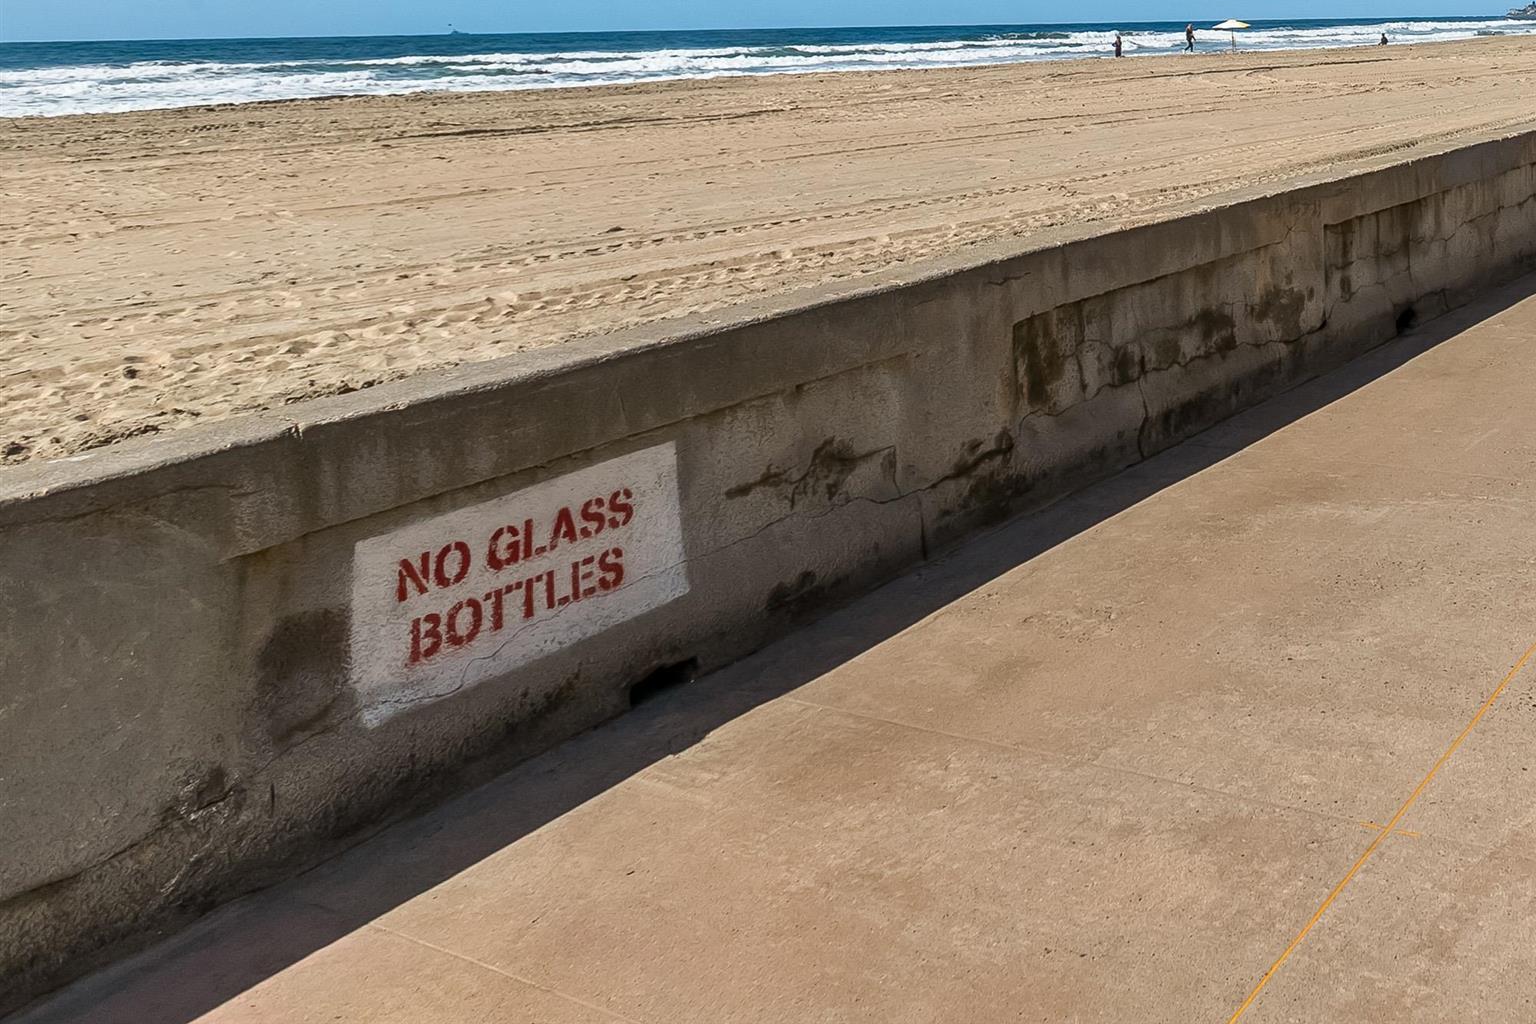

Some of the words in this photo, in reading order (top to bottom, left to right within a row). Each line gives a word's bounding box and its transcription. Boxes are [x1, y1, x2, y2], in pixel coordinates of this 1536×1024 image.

[394, 540, 472, 603] NO
[485, 487, 635, 571] GLASS
[405, 546, 625, 668] BOTTLES
